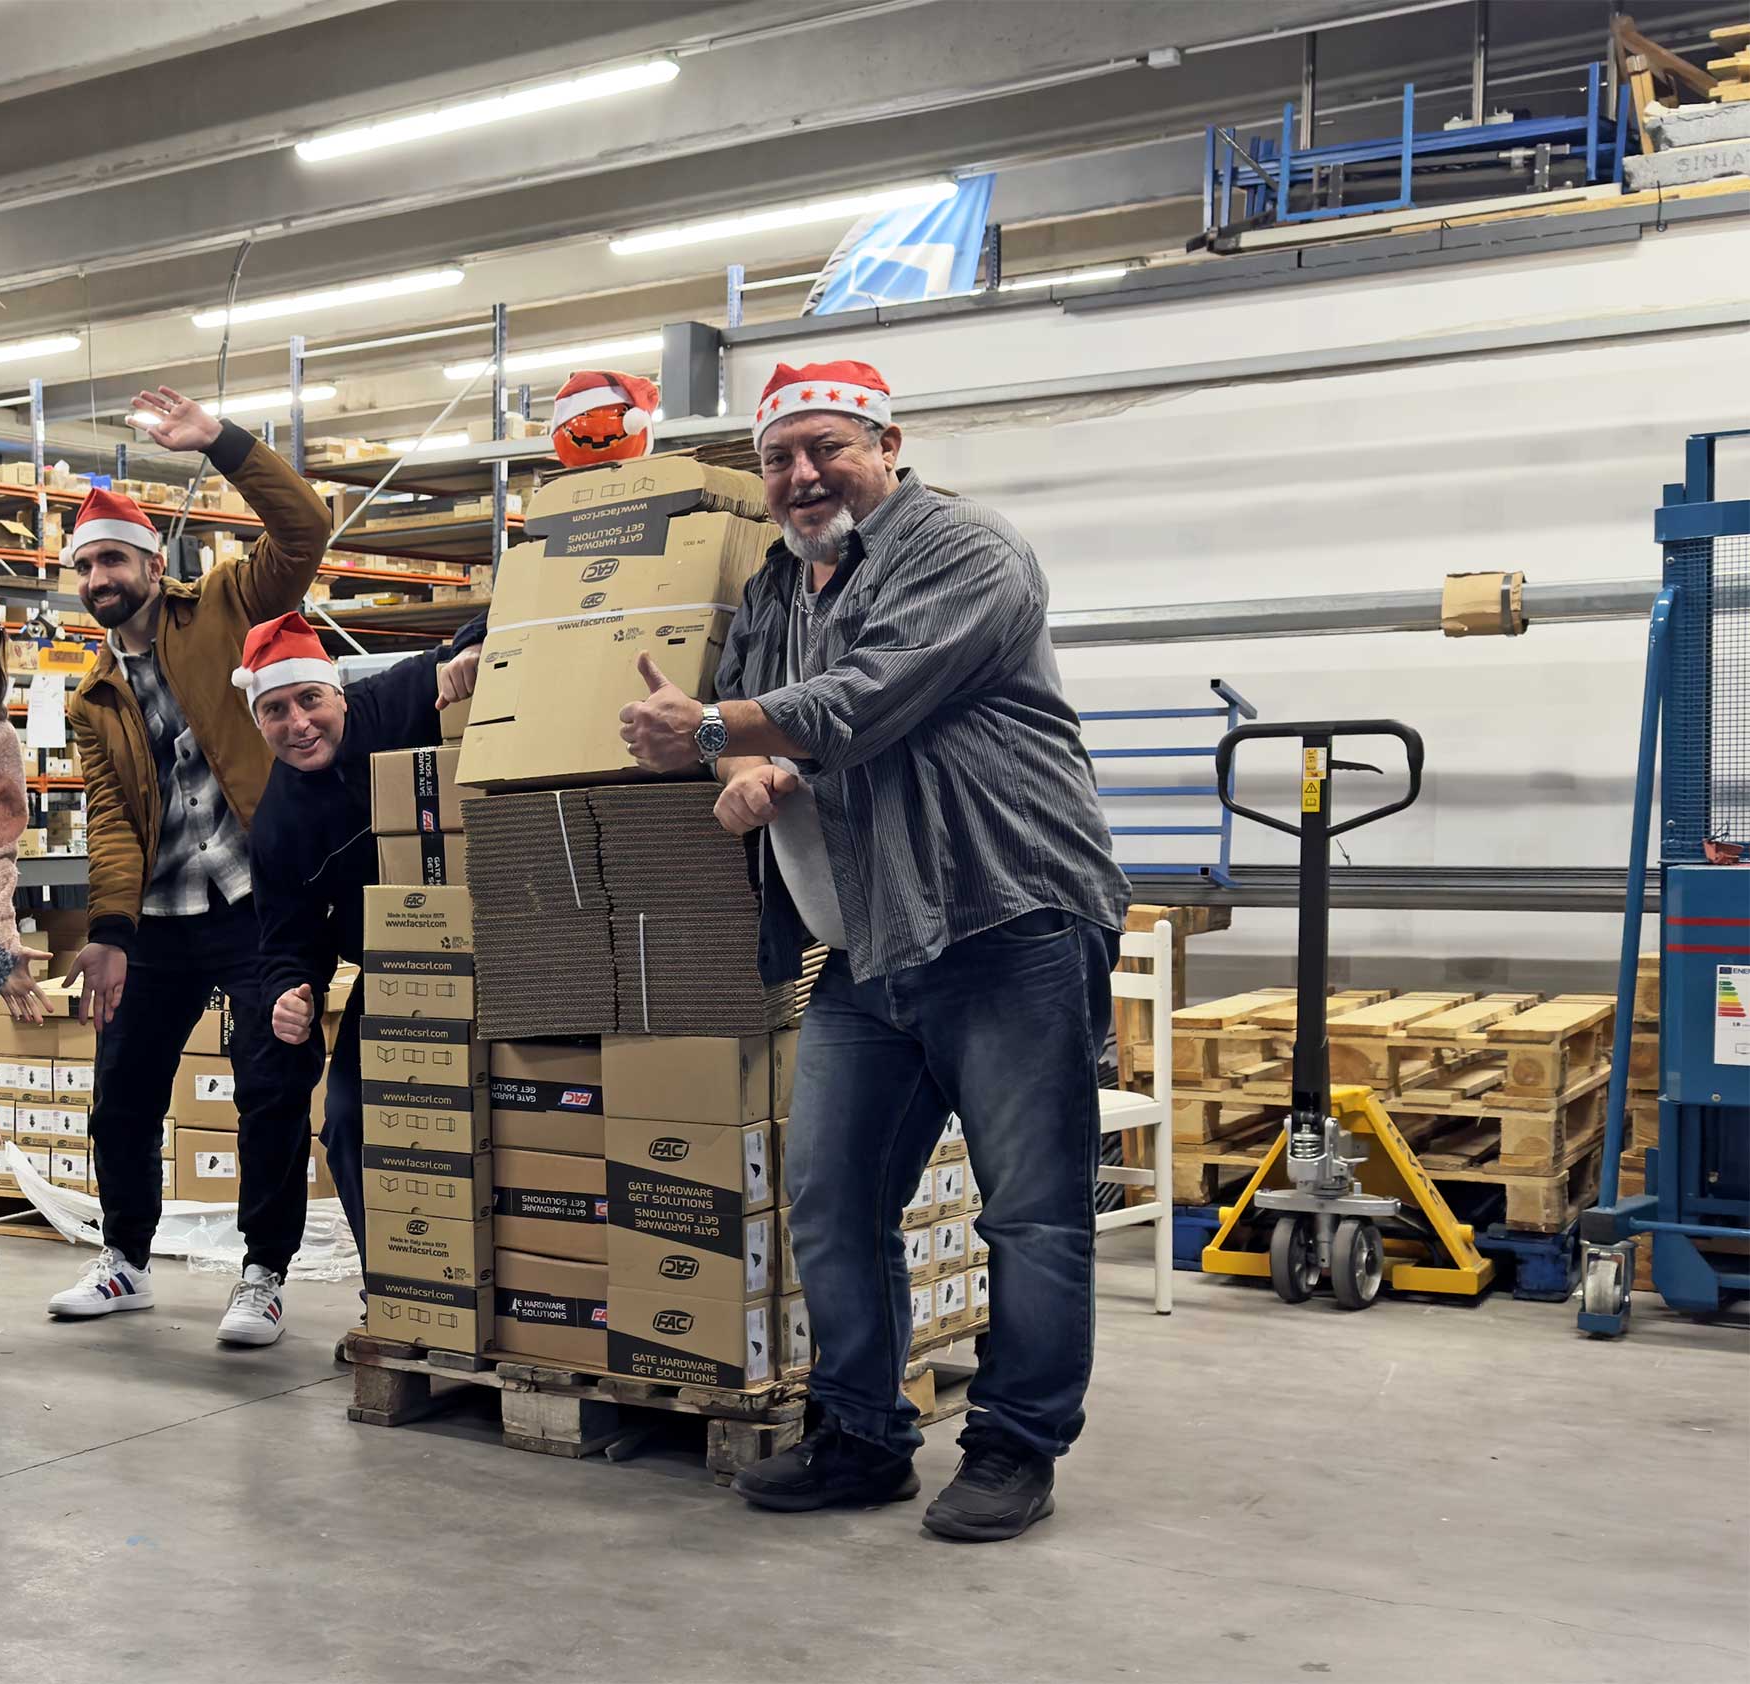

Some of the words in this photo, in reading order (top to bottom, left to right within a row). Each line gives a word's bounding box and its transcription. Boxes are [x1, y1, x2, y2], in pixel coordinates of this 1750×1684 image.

[1676, 149, 1750, 173] SINIA
[572, 503, 648, 522] www.facsrl.com
[625, 523, 645, 533] GET
[568, 527, 622, 543] SOLUTIONS
[620, 533, 643, 544] GATE
[566, 538, 617, 553] HARDWARE
[584, 560, 618, 580] FAC
[582, 594, 604, 607] FAC
[405, 895, 425, 907] FAC
[385, 920, 447, 928] www.facsrl.com
[382, 961, 452, 970] www.facsrl.com
[380, 1028, 449, 1038] www.facsrl.com
[520, 1085, 537, 1094] GET
[382, 1093, 452, 1104] www.facsrl.com
[516, 1094, 537, 1103] GATE
[563, 1092, 591, 1105] FAC
[650, 1140, 687, 1159] FAC
[382, 1157, 452, 1171] www.facsrl.com
[628, 1181, 653, 1193] GATE
[656, 1183, 714, 1199] HARDWARE
[521, 1195, 568, 1206] SOLUTIONS
[570, 1199, 587, 1208] GET
[628, 1192, 650, 1203] GET
[652, 1195, 714, 1210] SOLUTIONS
[521, 1203, 565, 1214] HARDWARE
[566, 1208, 587, 1217] GATE
[634, 1208, 695, 1222] SOLUTIONS
[635, 1218, 691, 1234] HARDWARE
[698, 1215, 720, 1226] GET
[408, 1222, 427, 1233] FAC
[694, 1225, 720, 1237] GATE
[388, 1243, 450, 1258] www.facsrl.com
[662, 1258, 697, 1277] FAC
[385, 1284, 454, 1301] www.facsrl.com
[523, 1300, 566, 1311] HARDWARE
[521, 1309, 567, 1320] SOLUTIONS
[654, 1312, 691, 1332] FAC
[632, 1353, 658, 1364] GATE
[660, 1357, 718, 1373] HARDWARE
[632, 1364, 652, 1374] GET
[656, 1368, 718, 1384] SOLUTIONS
